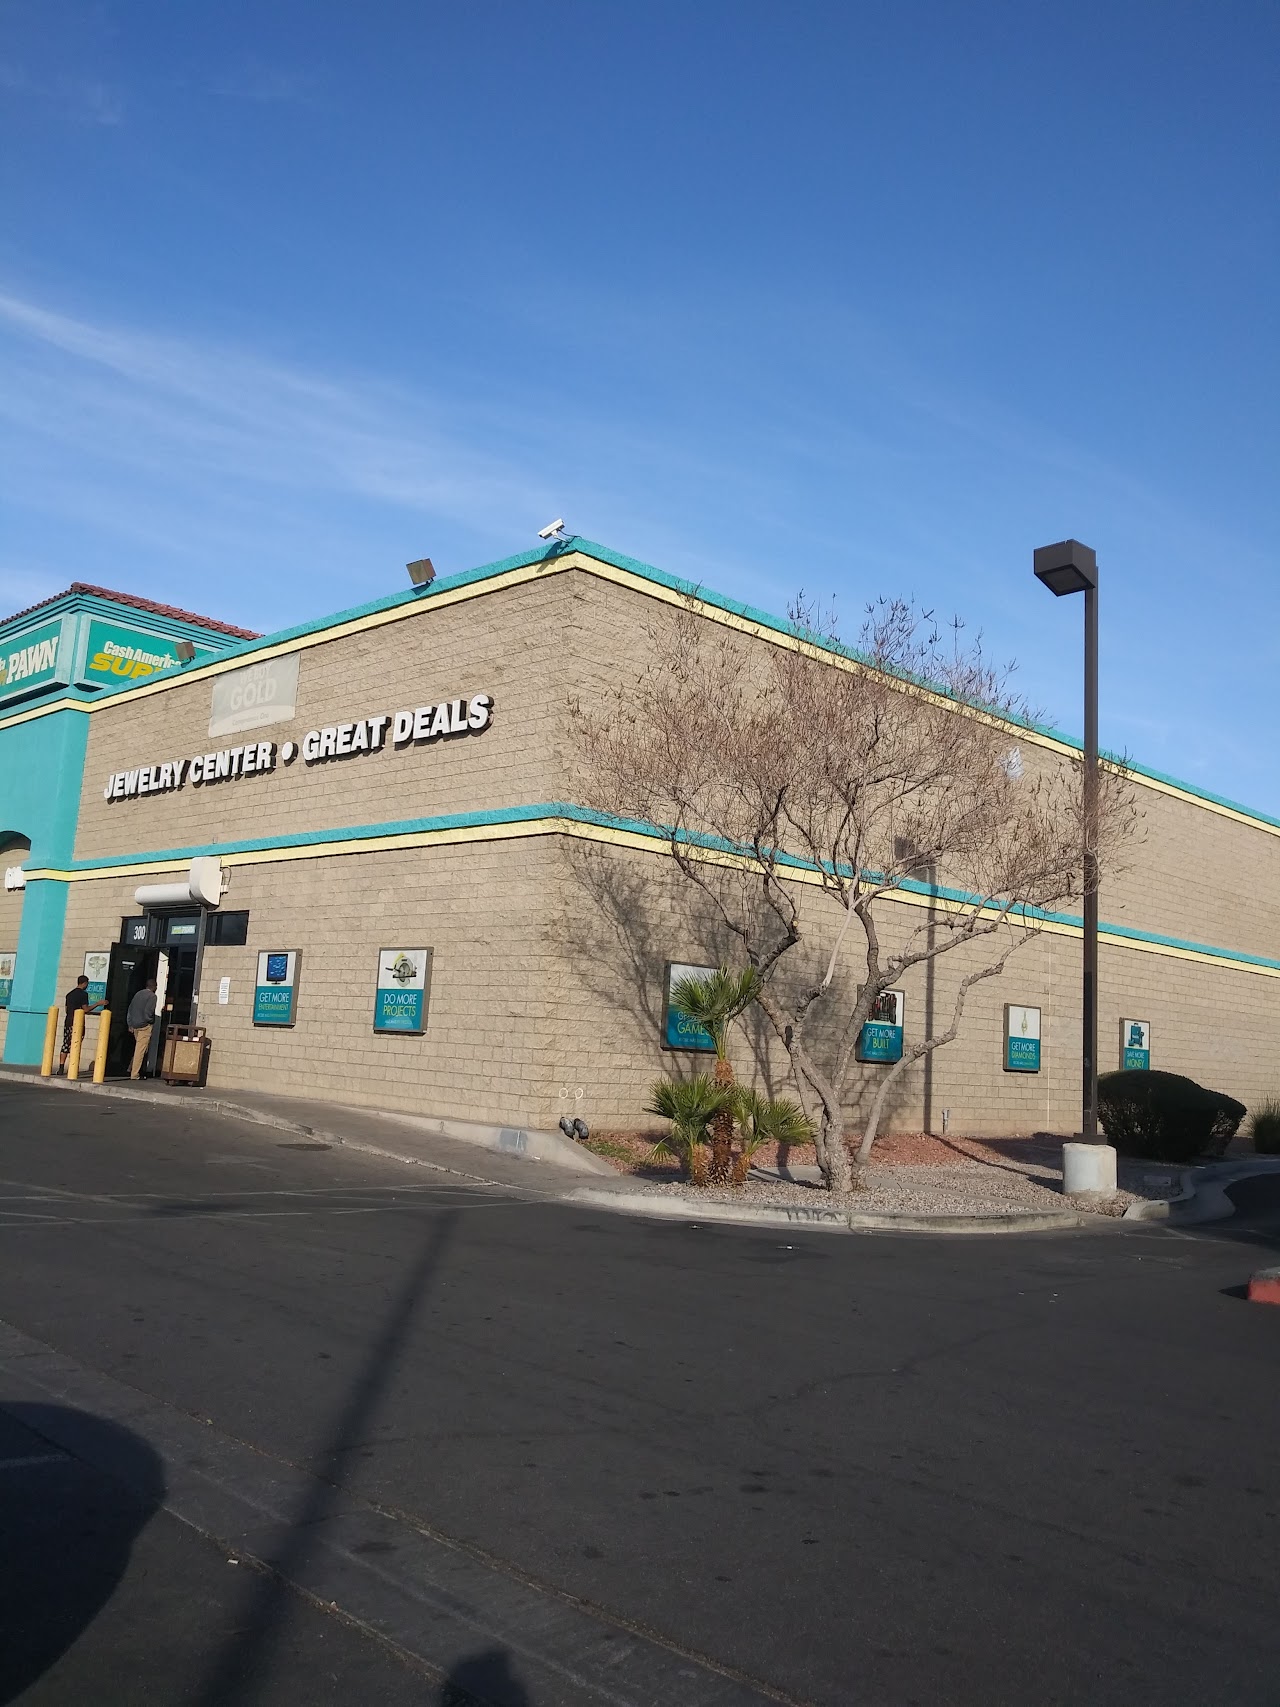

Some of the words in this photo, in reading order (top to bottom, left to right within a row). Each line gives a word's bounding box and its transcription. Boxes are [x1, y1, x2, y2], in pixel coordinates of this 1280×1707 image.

[104, 641, 134, 659] Cash
[6, 636, 59, 684] PAWN
[231, 678, 277, 710] GOLD
[104, 760, 185, 798] JEWELRY
[189, 742, 273, 782] CENTER
[303, 716, 386, 760] GREAT
[393, 694, 490, 743] DEALS
[134, 925, 146, 940] 300
[259, 992, 272, 1003] GET
[272, 992, 289, 1003] MORE
[384, 994, 396, 1004] DO
[397, 994, 417, 1005] MORE
[383, 1005, 416, 1017] PROJECTS
[867, 1028, 878, 1037] GET
[878, 1029, 896, 1039] MORE
[873, 1037, 889, 1049] BUILT
[1011, 1041, 1021, 1050] GET
[1021, 1042, 1036, 1052] MORE
[1127, 1059, 1145, 1069] MONEY
